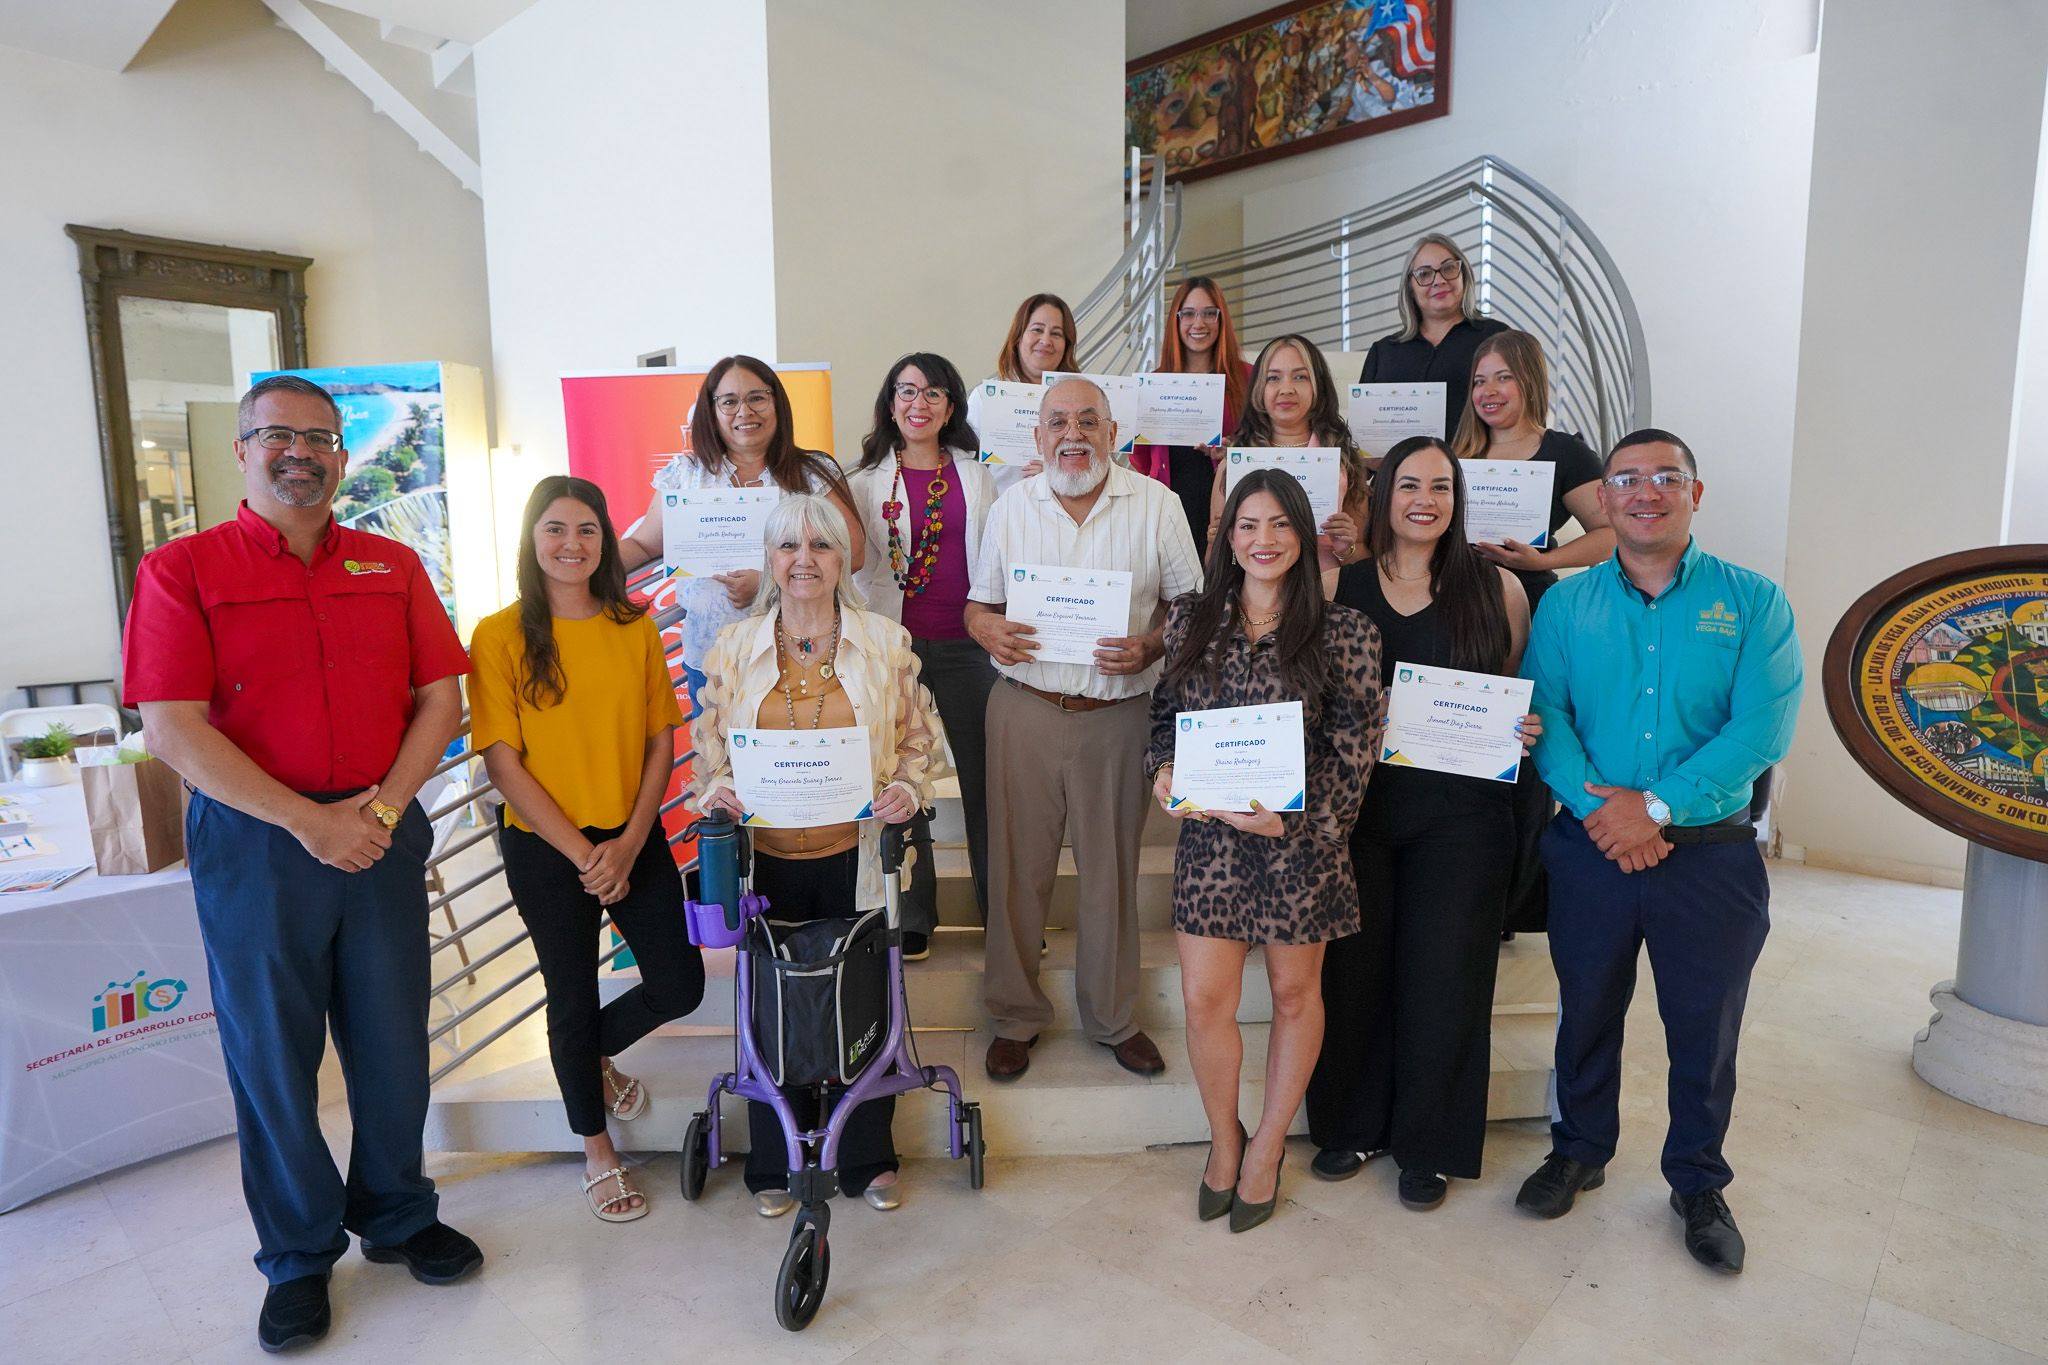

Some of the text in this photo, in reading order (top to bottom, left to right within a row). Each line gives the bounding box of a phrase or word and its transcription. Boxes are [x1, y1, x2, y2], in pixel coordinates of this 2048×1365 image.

[1046, 595, 1095, 606] CERTIFICADO
[1695, 624, 1717, 633] VEGA
[1433, 699, 1488, 714] CERTIFICADO
[1214, 738, 1266, 749] CERTIFICADO
[774, 760, 830, 768] CERTIFICADO
[1899, 744, 1919, 759] EN
[1910, 755, 1937, 775] SUS
[1930, 769, 1992, 808] VAIVENES
[1996, 803, 2028, 821] SON
[1986, 782, 2008, 796] SUR
[2012, 792, 2044, 806] CABO
[97, 1037, 112, 1047] DE
[115, 1017, 185, 1042] DESARROLLO
